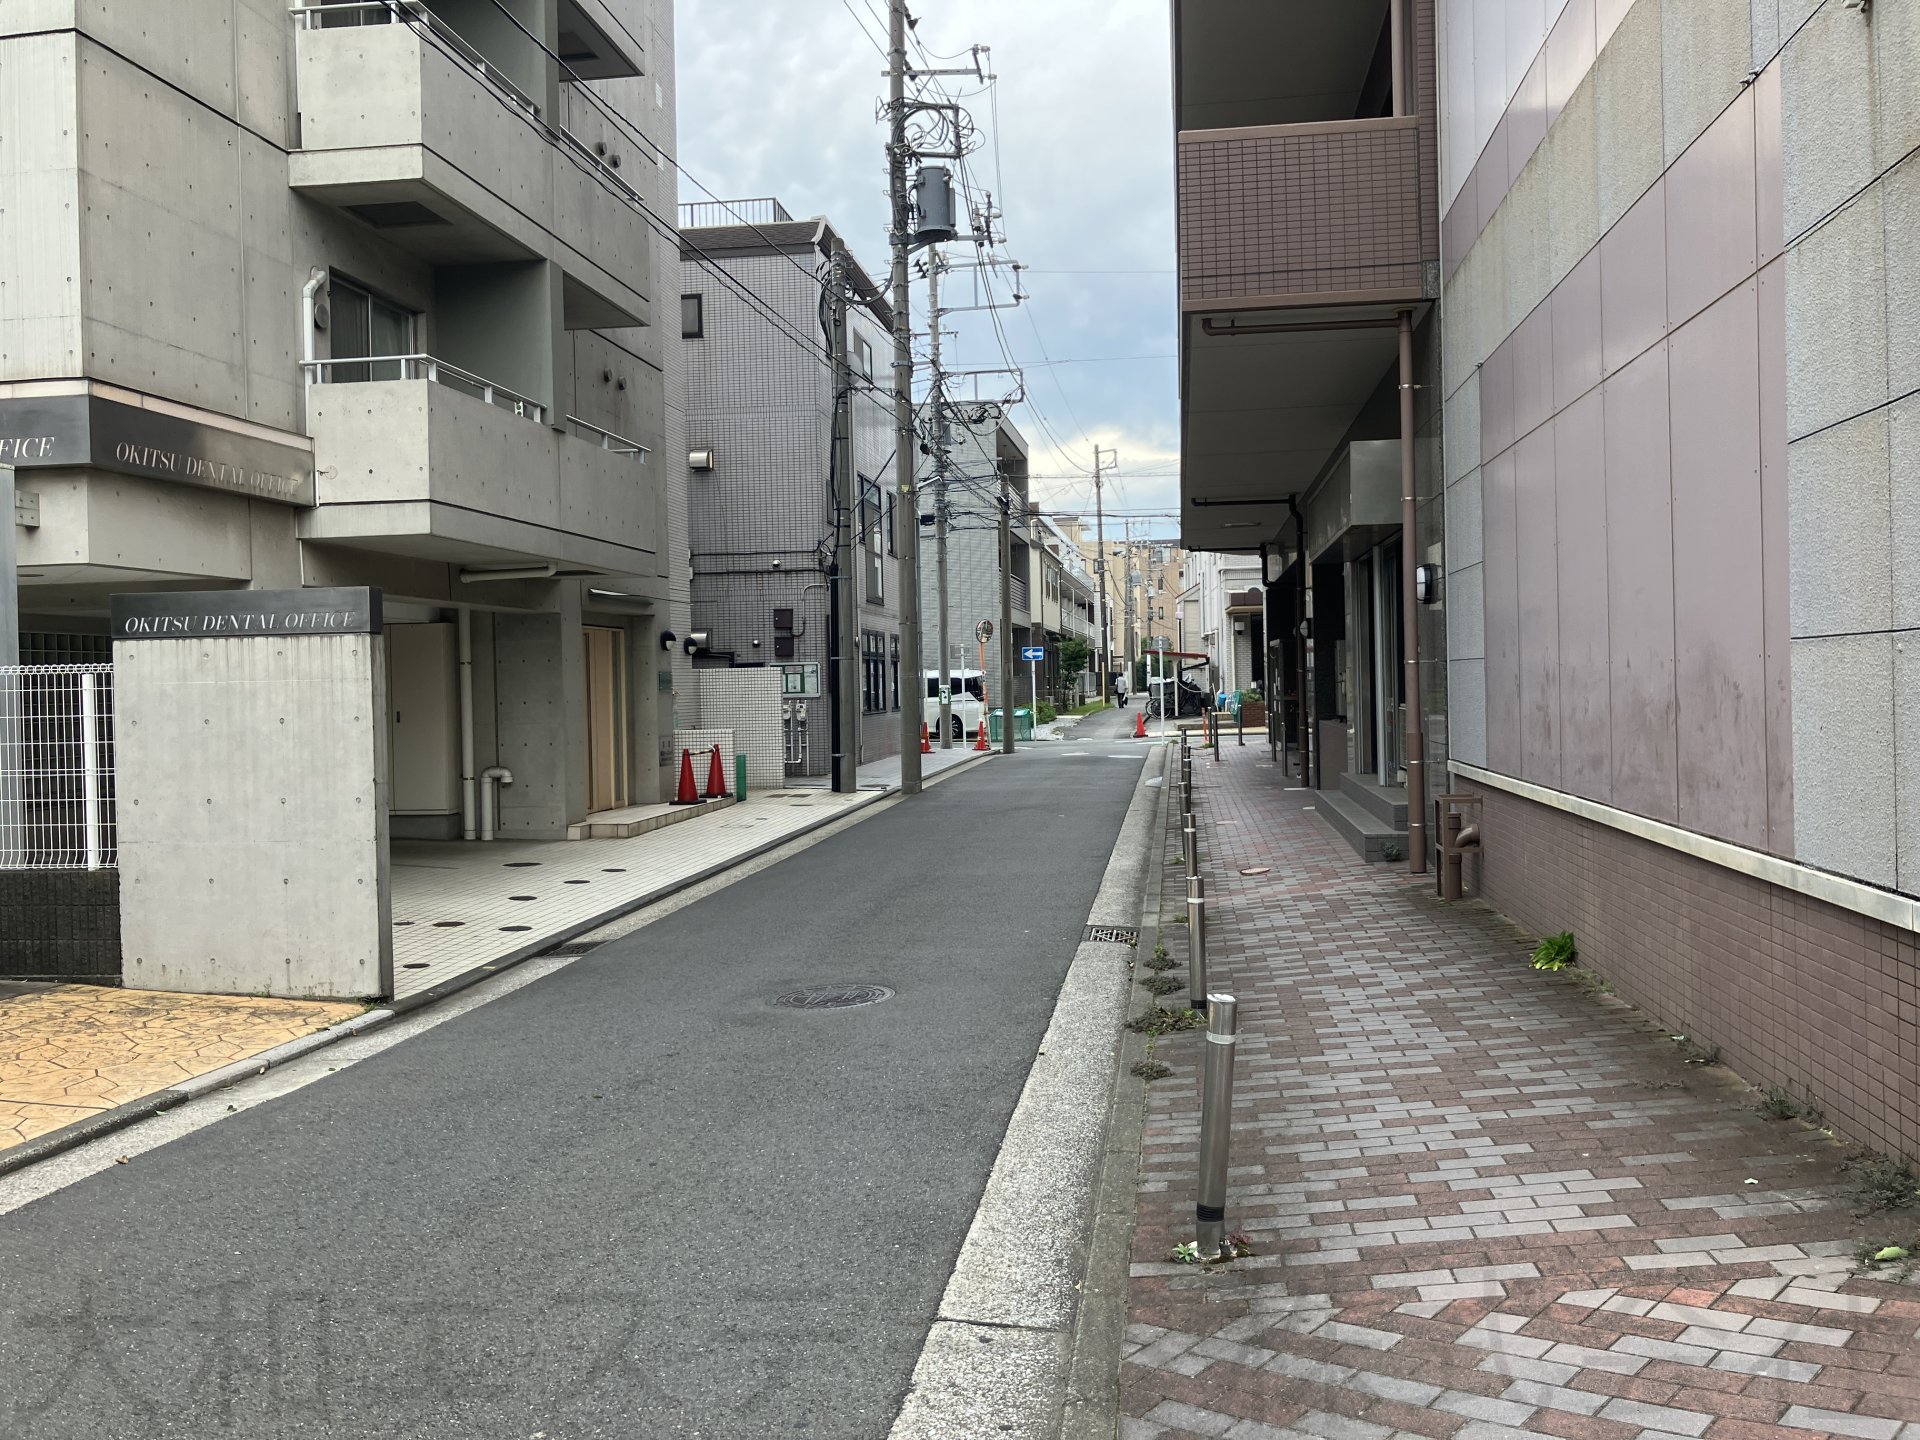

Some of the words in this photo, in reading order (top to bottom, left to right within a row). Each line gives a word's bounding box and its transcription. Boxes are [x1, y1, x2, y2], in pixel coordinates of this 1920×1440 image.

[116, 442, 183, 472] OKITSU
[186, 456, 245, 486] DENTAL
[250, 472, 299, 496] OFFICE
[125, 615, 197, 633] OKITSU
[203, 614, 279, 631] DENTAL
[285, 611, 356, 629] OFFICE
